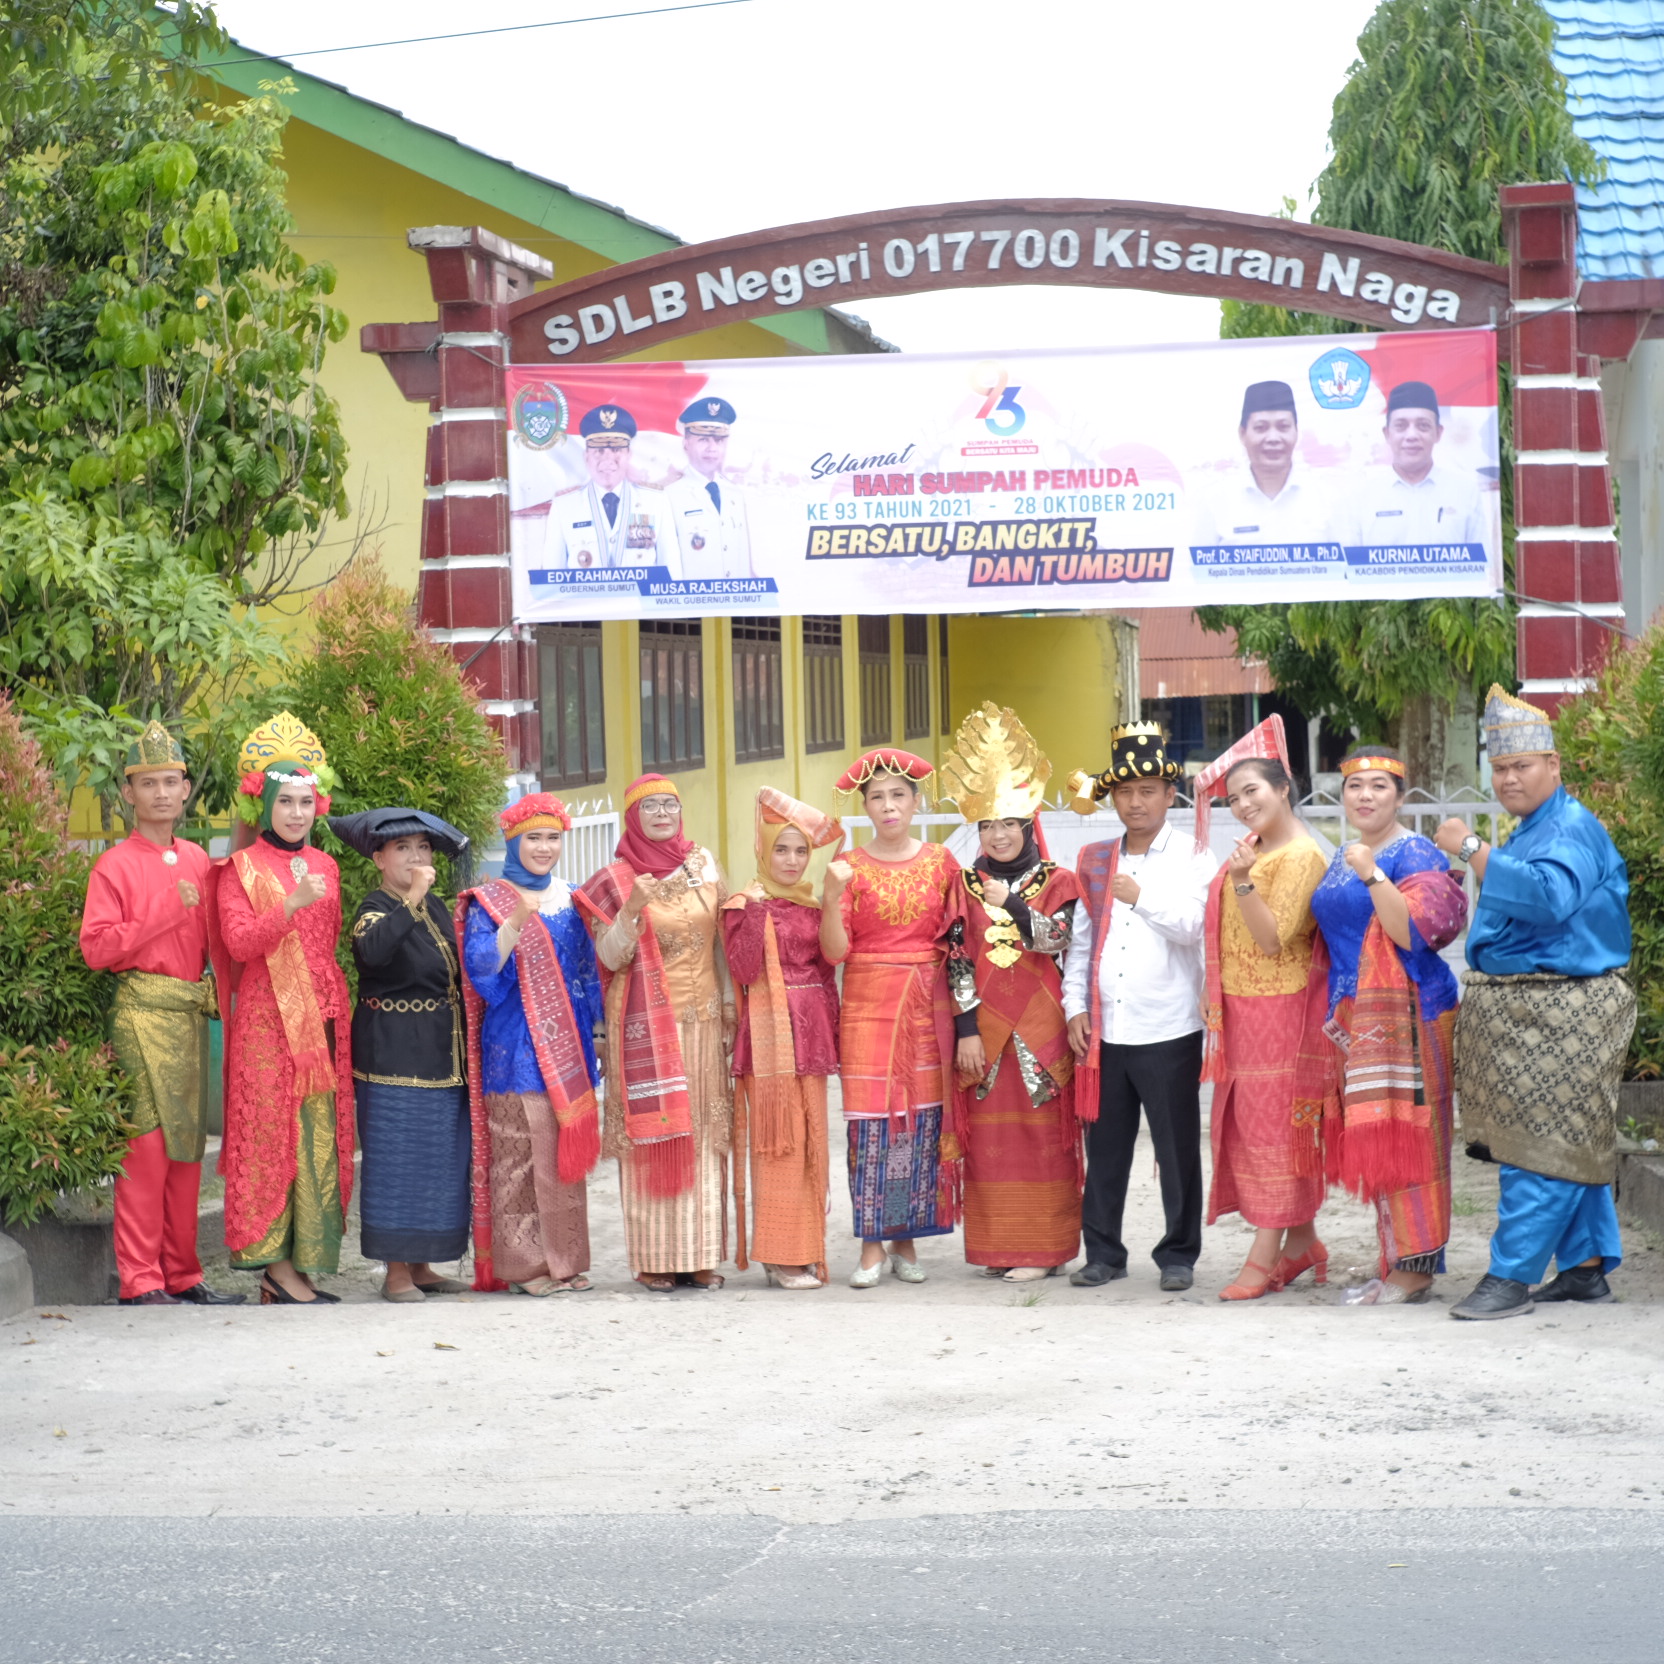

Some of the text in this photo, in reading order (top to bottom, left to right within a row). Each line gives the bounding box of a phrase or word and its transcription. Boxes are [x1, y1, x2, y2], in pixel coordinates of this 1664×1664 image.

[543, 227, 1461, 356] SDLB Negeri 017700 Kisaran Naga
[966, 439, 999, 447] SUMPAH
[810, 443, 917, 480] Selamat
[852, 467, 1140, 497] HARI SUMPAH PEMUDA
[807, 503, 829, 521] KE
[835, 502, 857, 520] 93
[864, 500, 923, 519] TAHUN
[929, 498, 971, 517] 2021
[1014, 497, 1036, 514] 28
[1043, 494, 1125, 513] OKTOBER
[1132, 493, 1175, 511] 2021
[808, 520, 1095, 557] BERSATU, BANGKIT,
[1196, 549, 1218, 564] Prof.
[1219, 549, 1232, 563] Dr.
[1317, 545, 1339, 560] Ph.D
[1368, 546, 1471, 563] KURNIA UTAMA
[547, 568, 648, 583] EDY RAHMAYADI
[971, 551, 1170, 583] DAN TUMBUH
[1208, 568, 1228, 578] Kepala
[1229, 567, 1245, 576] Dinas
[1246, 566, 1278, 576] Pendidikan
[1311, 565, 1327, 574] Utara
[1355, 564, 1485, 576] KACABDIS PENDIDIKAN KISARAN
[559, 583, 636, 593] GUBERNUR SUMUT
[650, 580, 767, 595] MUSA RAJEKSHAH
[655, 594, 762, 605] WAKIL GUBERNUR SUMUT
